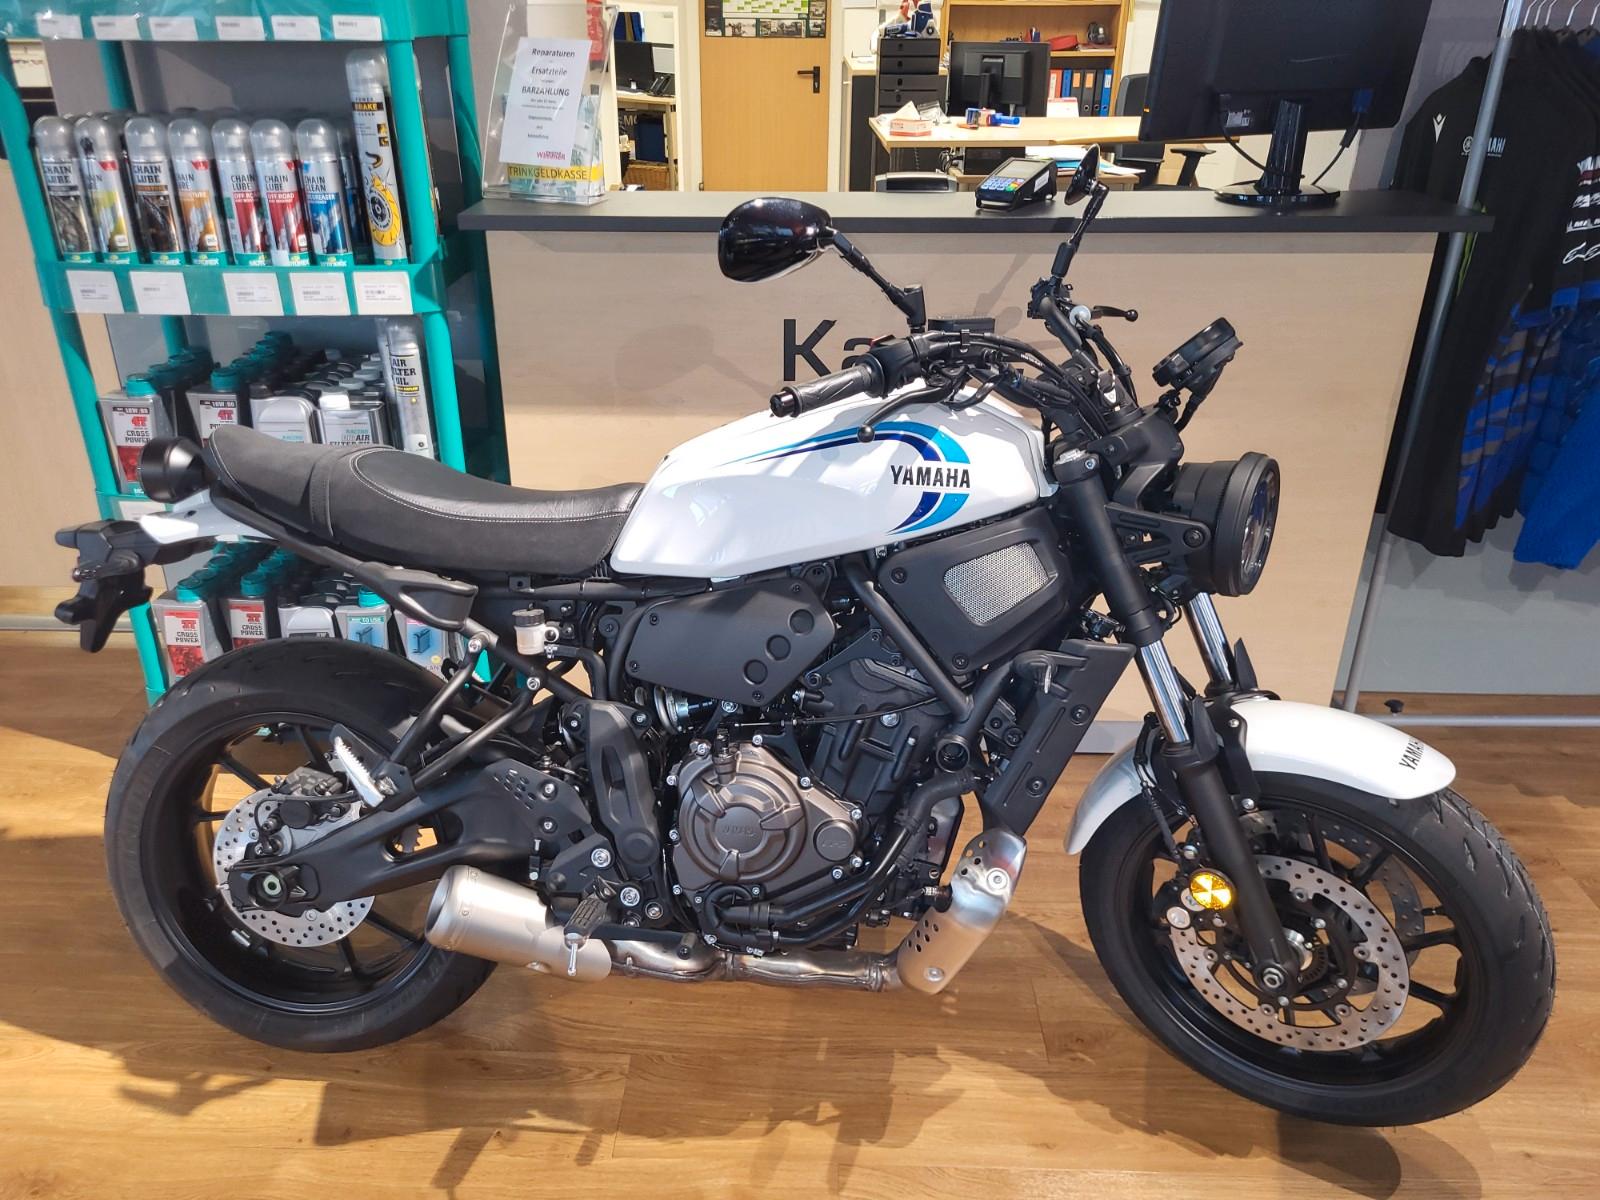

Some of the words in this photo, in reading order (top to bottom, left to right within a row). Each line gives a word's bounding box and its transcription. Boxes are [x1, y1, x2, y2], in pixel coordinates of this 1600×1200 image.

[531, 48, 575, 57] Reparaturen
[521, 86, 570, 96] BARZAHLUNG
[508, 165, 588, 180] TRINKGELDKASSE
[265, 175, 289, 183] CHAIN
[890, 465, 971, 489] YAMAHA
